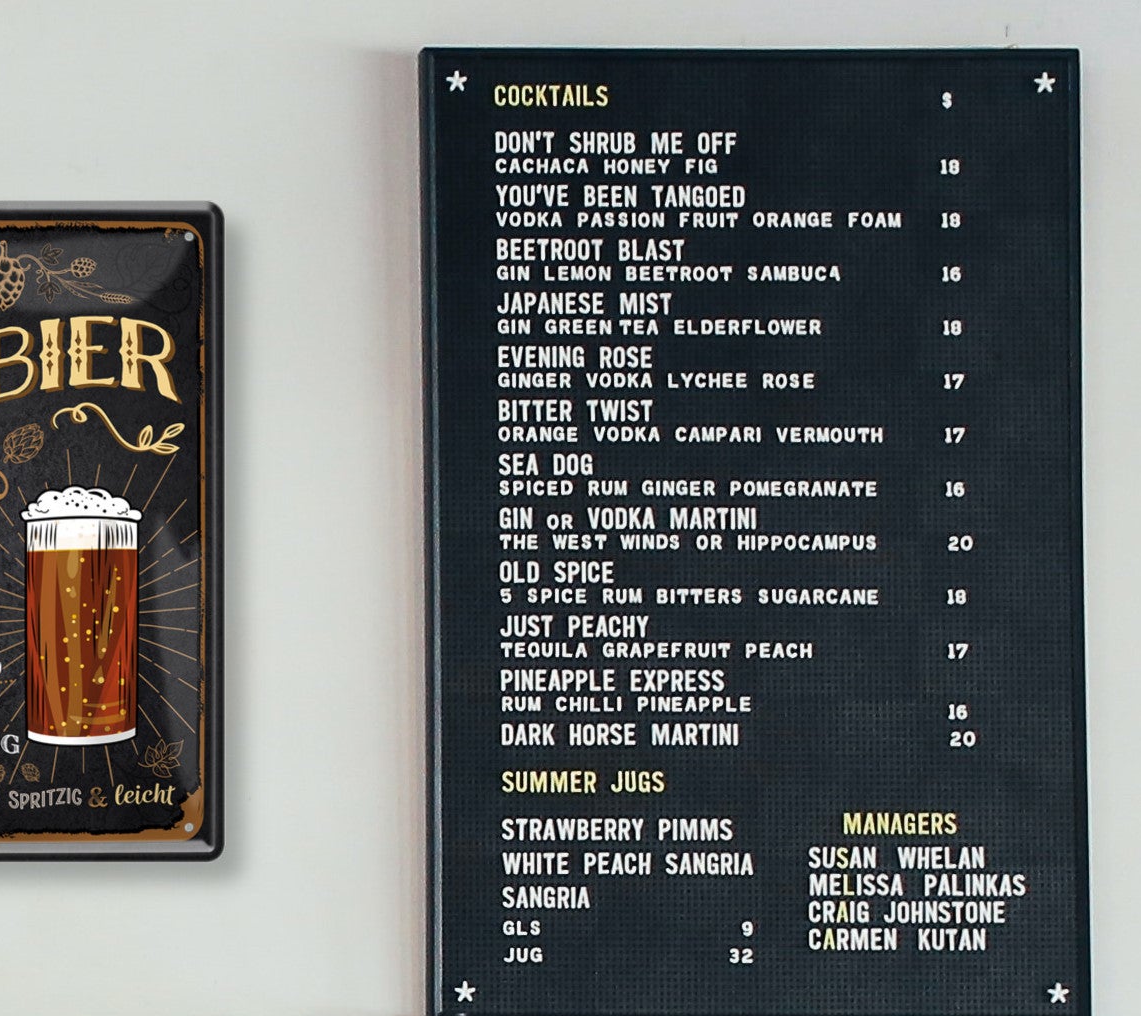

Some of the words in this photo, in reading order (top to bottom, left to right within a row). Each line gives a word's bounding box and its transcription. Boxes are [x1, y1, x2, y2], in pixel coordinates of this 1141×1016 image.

[494, 84, 609, 107] COCKTAILS
[494, 130, 555, 155] DON'T
[569, 131, 636, 155] SHRUB
[650, 131, 684, 155] ME
[697, 131, 737, 155] OFF
[495, 157, 589, 175] CACHACA
[603, 158, 671, 175] HONEY
[685, 158, 718, 175] FIG
[940, 158, 960, 176] 18
[495, 183, 569, 208] YOU'VE
[583, 184, 637, 208] BEEN
[650, 184, 746, 209] TANGOED
[495, 211, 563, 228] VODKA
[577, 211, 665, 229] PASSION
[679, 211, 739, 229] FRUIT
[752, 211, 833, 229] ORANGE
[847, 211, 902, 229] FOAM
[941, 212, 961, 229] 18
[496, 238, 604, 262] BEETROOT
[618, 238, 685, 262] BLAST
[496, 291, 605, 315] JAPANESE
[619, 292, 672, 316] MIST
[497, 318, 531, 335] GIN
[544, 318, 613, 336] GREEN
[618, 318, 659, 336] TEA
[673, 318, 822, 336] ELDERFLOWER
[942, 319, 962, 336] 18
[497, 345, 585, 369] EVENING
[599, 345, 653, 370] ROSE
[498, 399, 573, 423] BITTER
[585, 399, 653, 423] TWIST
[497, 425, 578, 443] ORANGE
[593, 425, 661, 443] VODKA
[674, 426, 762, 443] CAMPARI
[776, 426, 884, 444] VERMOUTH
[944, 427, 966, 444] 17
[498, 453, 539, 476] SEA
[552, 453, 594, 476] DOG
[499, 479, 574, 497] SPICED
[587, 479, 628, 497] RUM
[641, 479, 716, 497] GINGER
[729, 480, 878, 498] POMEGRANATE
[945, 480, 965, 498] 16
[499, 506, 533, 530] GIN
[546, 513, 574, 531] OR
[586, 506, 656, 530] VODKA
[669, 506, 757, 531] MARTINI
[499, 533, 539, 551] THE
[552, 533, 608, 551] WEST
[619, 533, 680, 551] WINDS
[695, 534, 723, 551] OR
[737, 534, 877, 552] HIPPOCAMPUS
[947, 535, 974, 552] 20
[499, 560, 540, 584] OLD
[553, 560, 615, 584] SPICE
[499, 587, 512, 604] 5
[527, 587, 587, 605] SPICE
[602, 587, 643, 605] RUM
[656, 587, 743, 605] BITTERS
[758, 588, 879, 606] SUGARCANE
[947, 588, 967, 605] 18
[499, 614, 554, 638] JUST
[567, 614, 649, 639] PEACHY
[500, 641, 588, 659] TEQUILA
[602, 641, 731, 659] GRAPEFRUIT
[745, 642, 813, 659] PEACH
[947, 643, 969, 660] 17
[500, 668, 616, 693] PINEAPPLE
[630, 669, 725, 693] EXPRESS
[501, 695, 542, 712] RUM
[555, 695, 623, 713] CHILLI
[637, 695, 752, 713] PINEAPPLE
[947, 703, 968, 721] 16
[501, 722, 555, 747] DARK
[569, 722, 637, 747] HORSE
[651, 722, 739, 747] MARTINI
[949, 730, 977, 748] 20
[501, 770, 597, 794] SUMMER
[610, 770, 665, 793] JUGS
[8, 787, 83, 810] SPRITZIG
[87, 786, 109, 808] &
[114, 783, 176, 806] leicht
[501, 817, 644, 842] STRAWBERRY
[658, 817, 734, 842] PIMMS
[843, 812, 958, 836] MANAGERS
[502, 851, 570, 876] WHITE
[583, 851, 652, 876] PEACH
[664, 852, 754, 876] SANGRIA
[808, 845, 877, 870] SUSAN
[897, 846, 985, 870] WHELAN
[502, 885, 591, 910] SANGRIA
[809, 873, 904, 897] MELISSA
[924, 873, 1027, 898] PALINKAS
[808, 900, 870, 924] CRAIG
[883, 900, 1006, 925] JOHNSTONE
[502, 920, 541, 936] GLS
[741, 920, 754, 937] 9
[808, 927, 898, 951] CARMEN
[917, 927, 987, 952] KUTAN
[503, 946, 543, 963] JUG
[729, 947, 754, 964] 32
